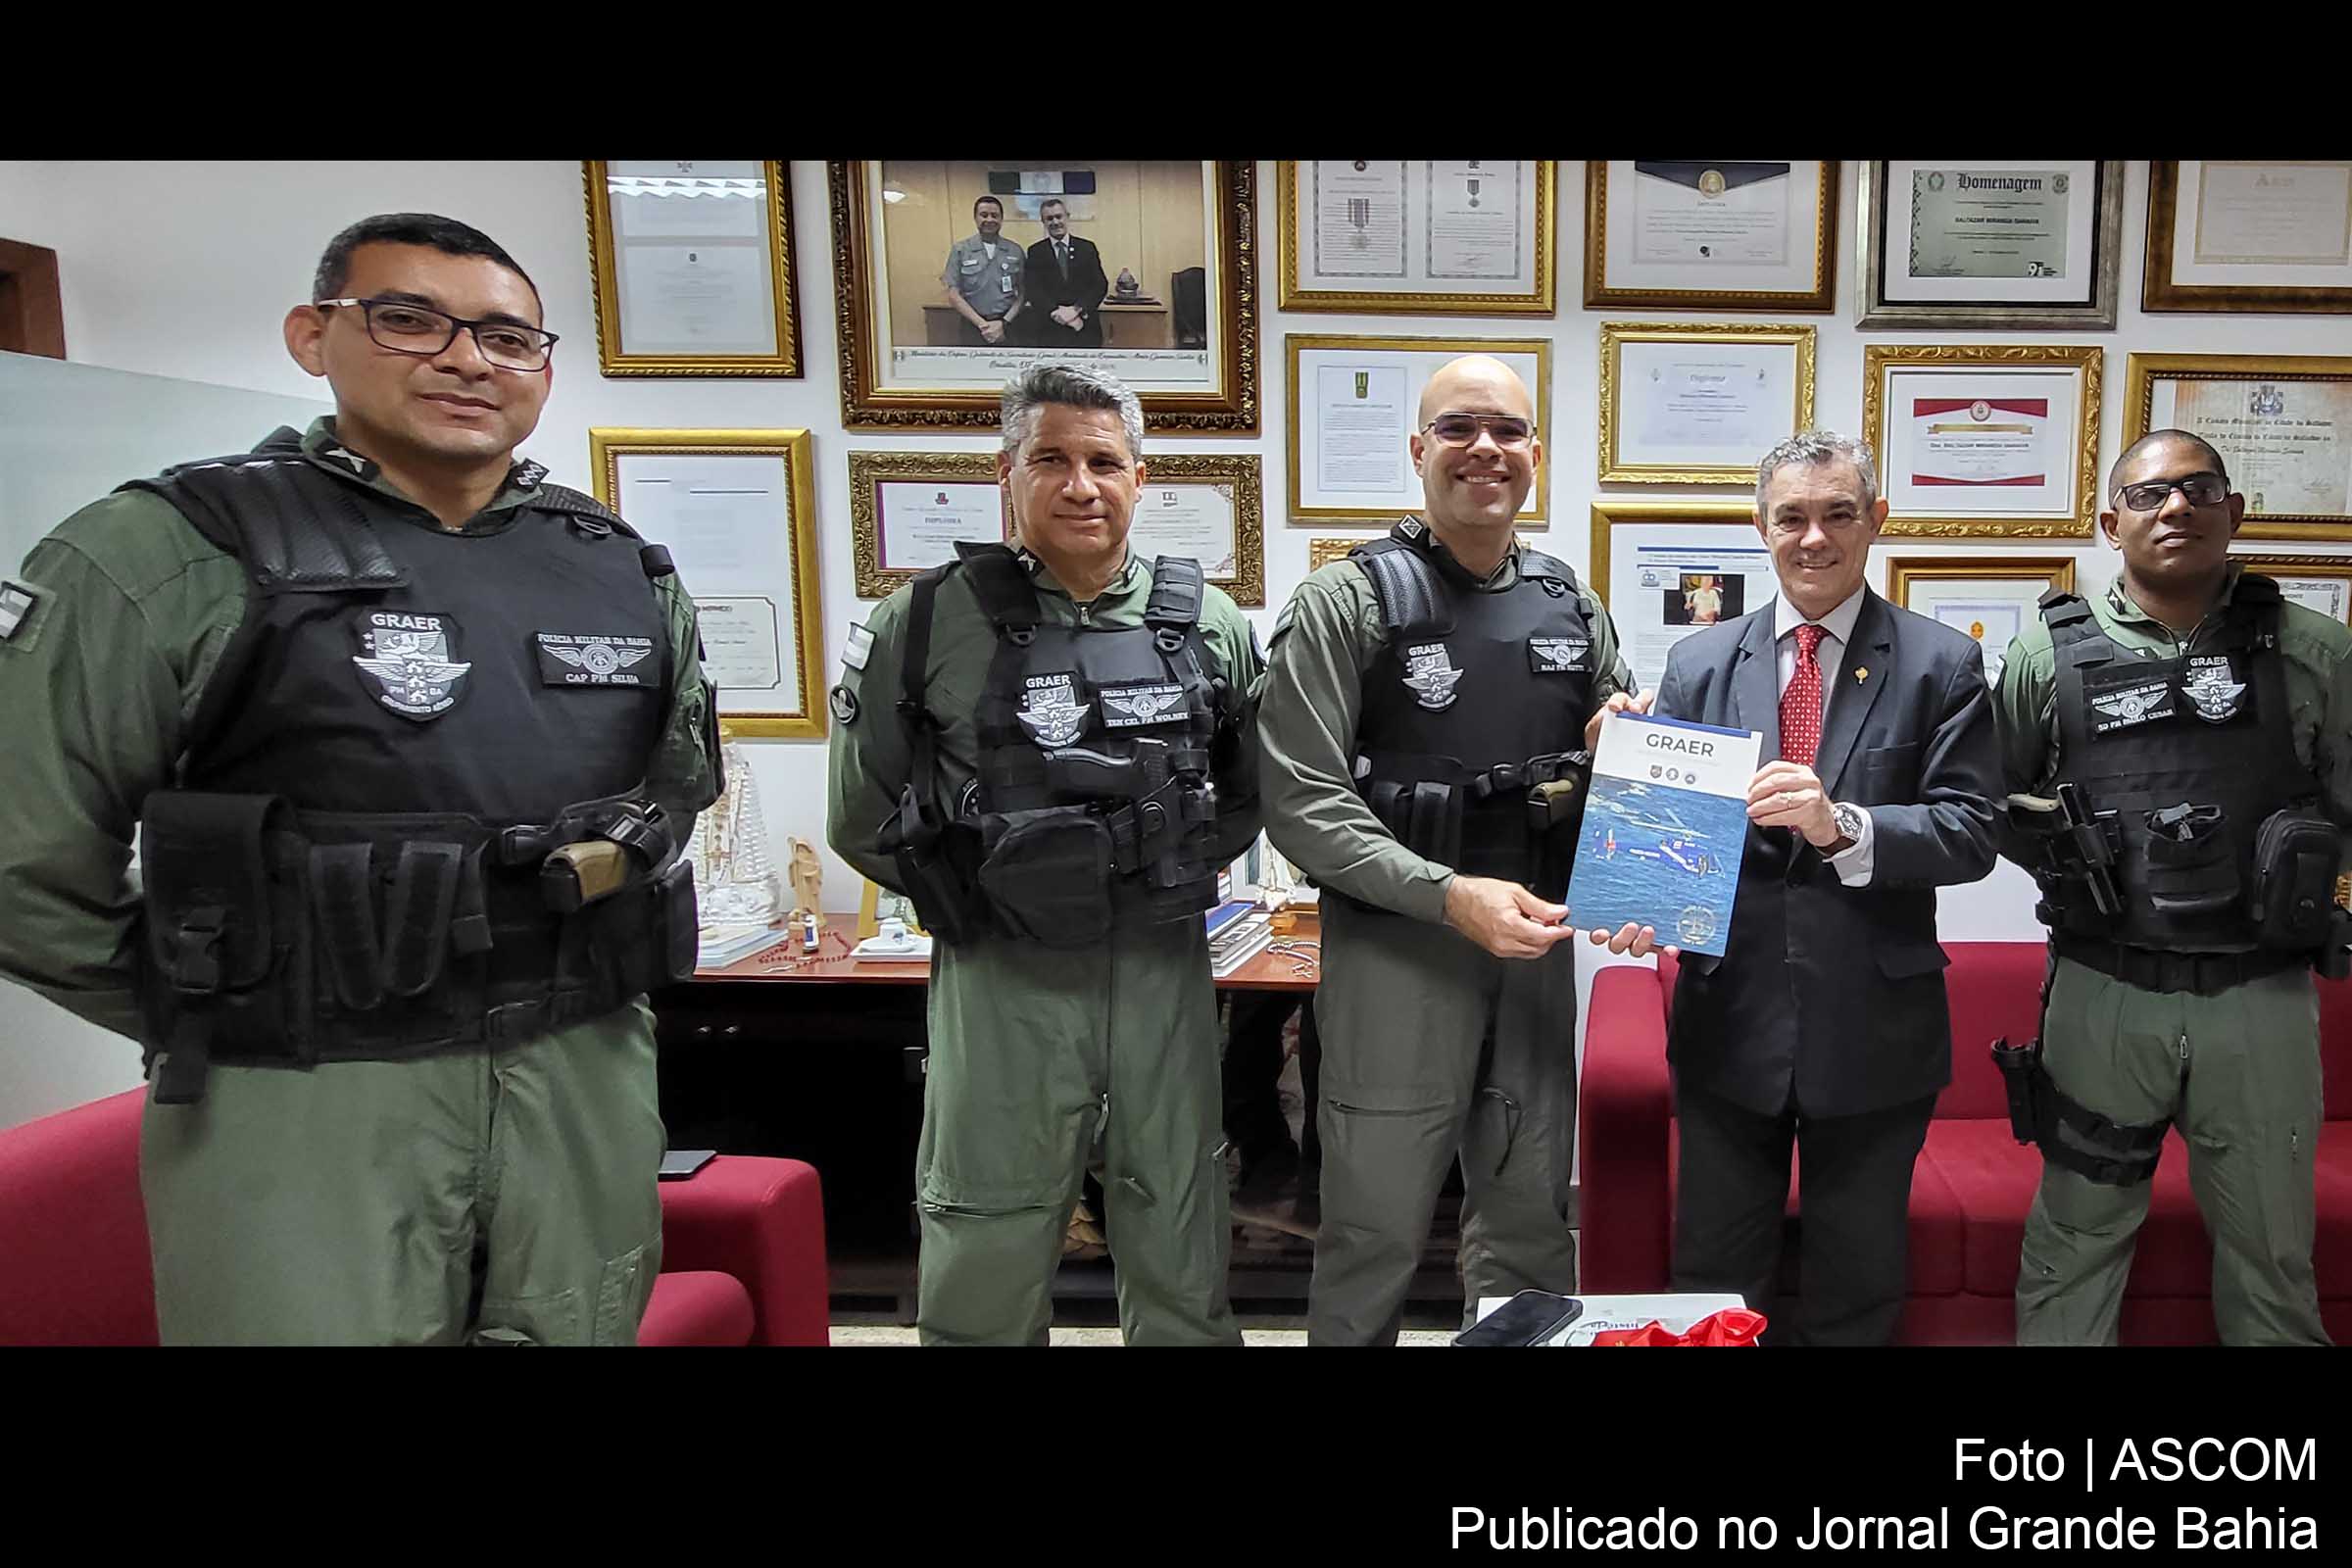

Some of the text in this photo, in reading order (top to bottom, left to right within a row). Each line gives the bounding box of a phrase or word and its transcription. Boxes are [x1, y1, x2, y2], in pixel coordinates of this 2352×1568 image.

[1957, 172, 2042, 193] Homenagem
[370, 613, 444, 630] GRAER
[1408, 643, 1446, 657] GRAER
[2189, 656, 2230, 667] GRAER
[565, 673, 588, 683] CAP
[611, 674, 639, 684] SILVA
[1026, 674, 1071, 688] GRAER
[1646, 733, 1714, 758] GRAER
